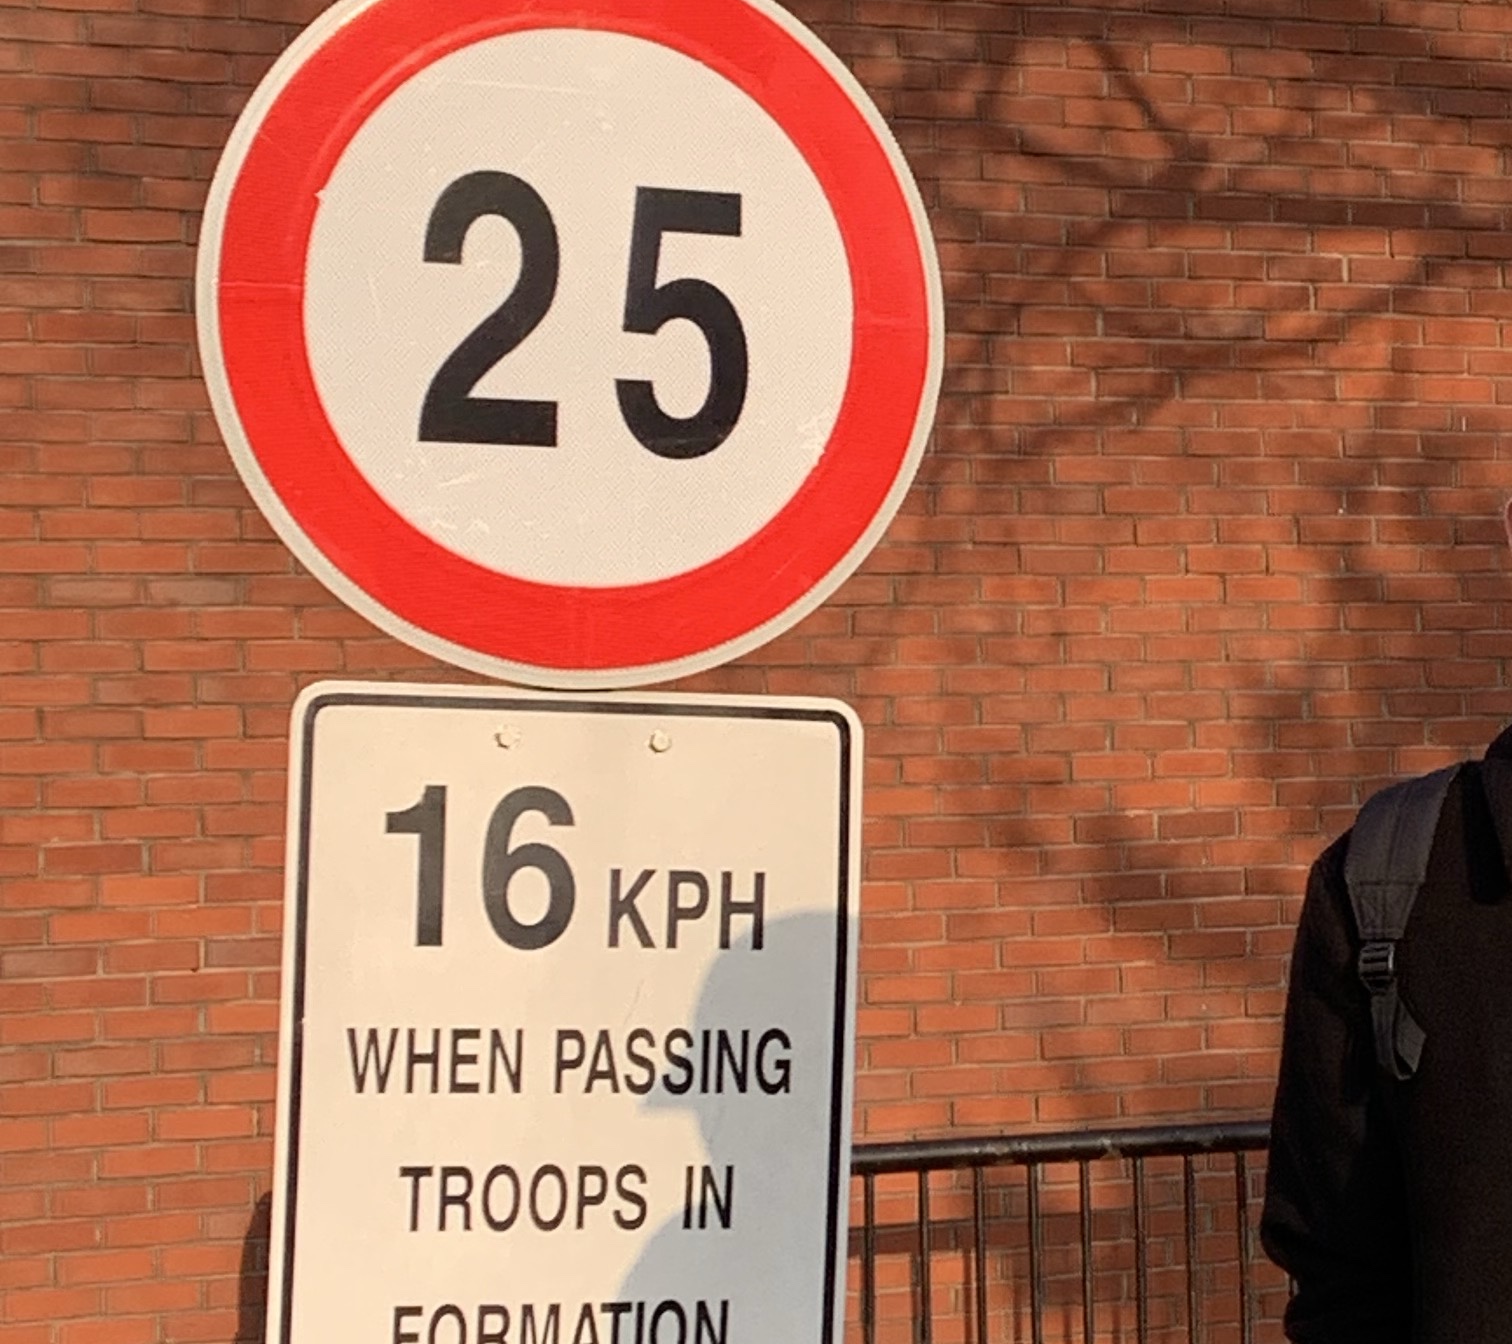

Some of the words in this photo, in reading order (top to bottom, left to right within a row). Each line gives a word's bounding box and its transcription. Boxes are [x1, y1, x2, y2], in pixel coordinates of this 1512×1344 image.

[417, 170, 750, 460] 25
[385, 784, 577, 951] 16
[608, 868, 767, 951] KPH
[346, 1027, 525, 1095] WHEN
[553, 1027, 793, 1096] PASSING
[399, 1163, 648, 1233] TROOPS
[682, 1164, 735, 1231] IN
